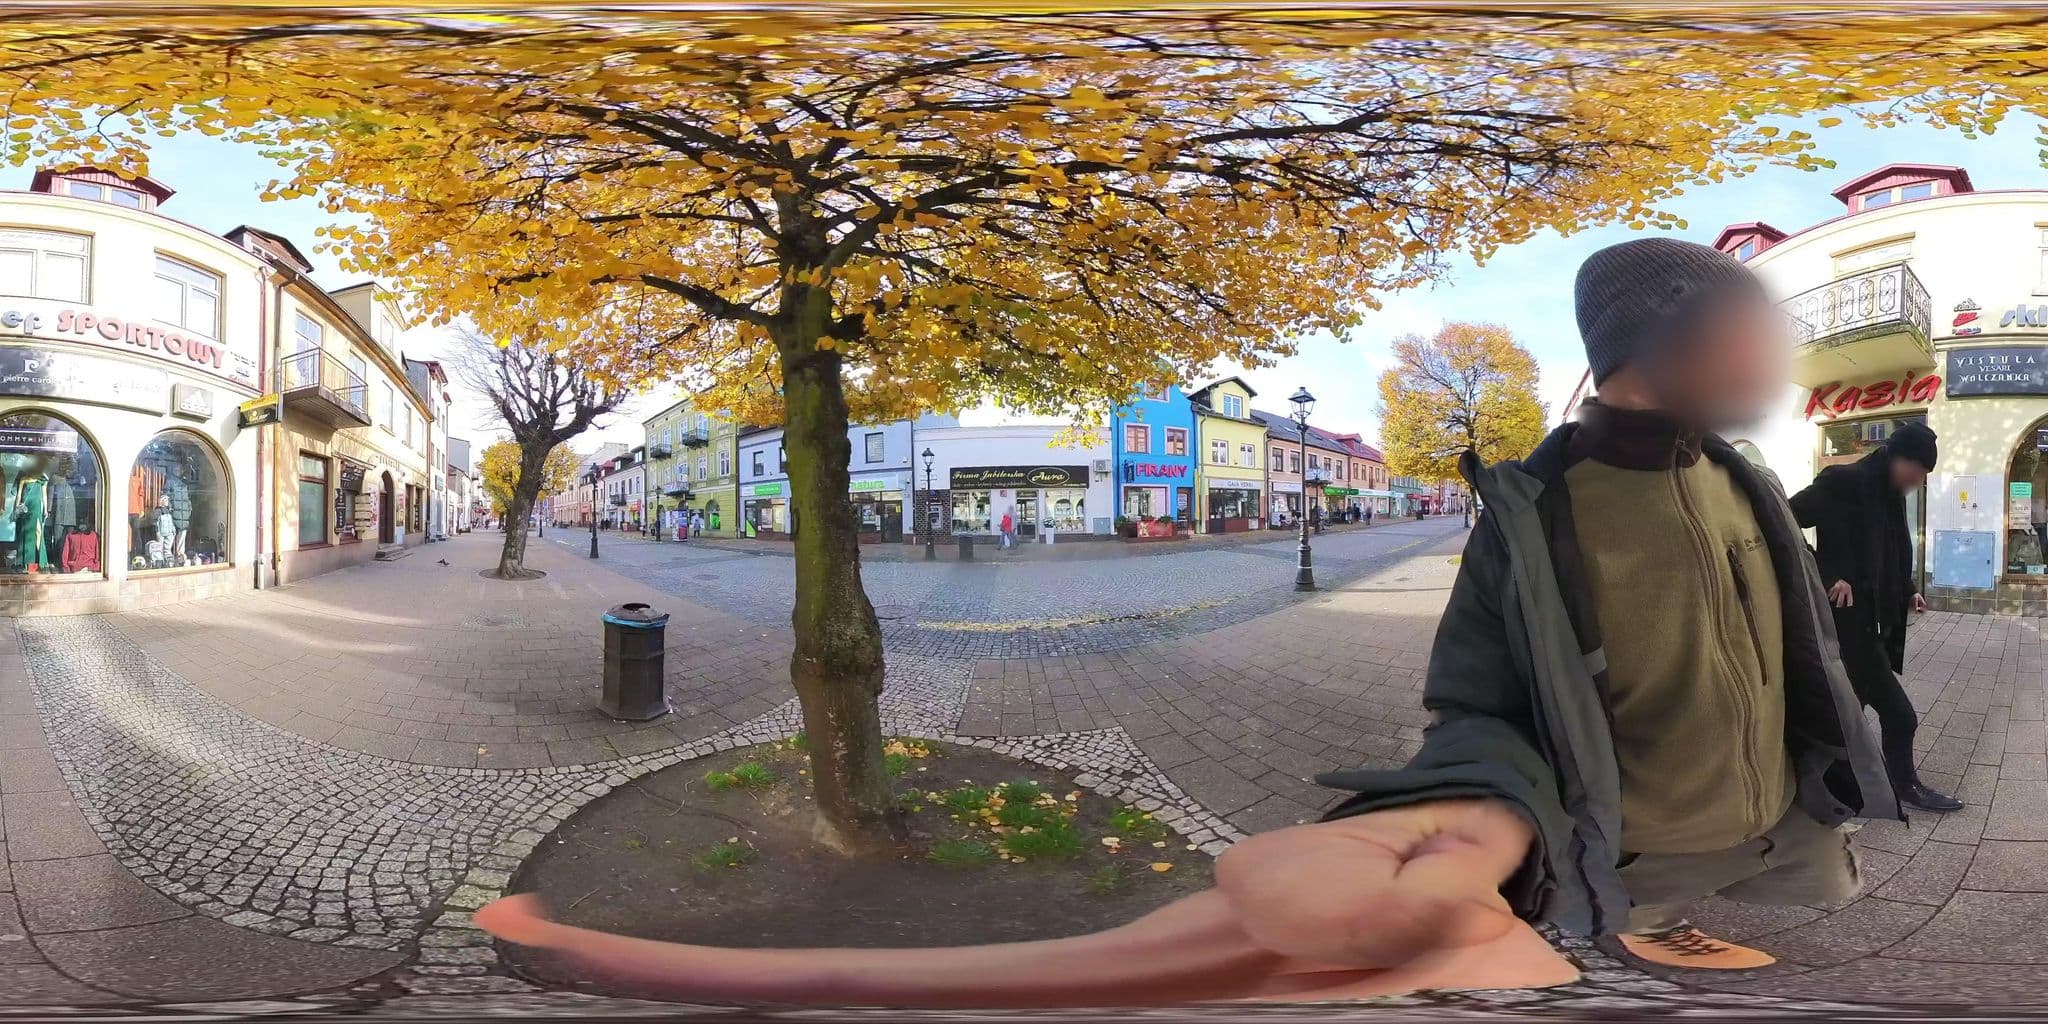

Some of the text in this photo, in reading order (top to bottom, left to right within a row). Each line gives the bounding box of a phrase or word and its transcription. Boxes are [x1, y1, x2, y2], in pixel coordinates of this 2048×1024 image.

[57, 310, 225, 368] SPORTOWY
[1954, 355, 2036, 368] VISTULA
[1, 375, 30, 385] pierre
[1804, 370, 1942, 421] Kasia
[952, 471, 979, 480] Firma
[1032, 471, 1065, 482] Aura
[1136, 463, 1188, 478] FIRANY
